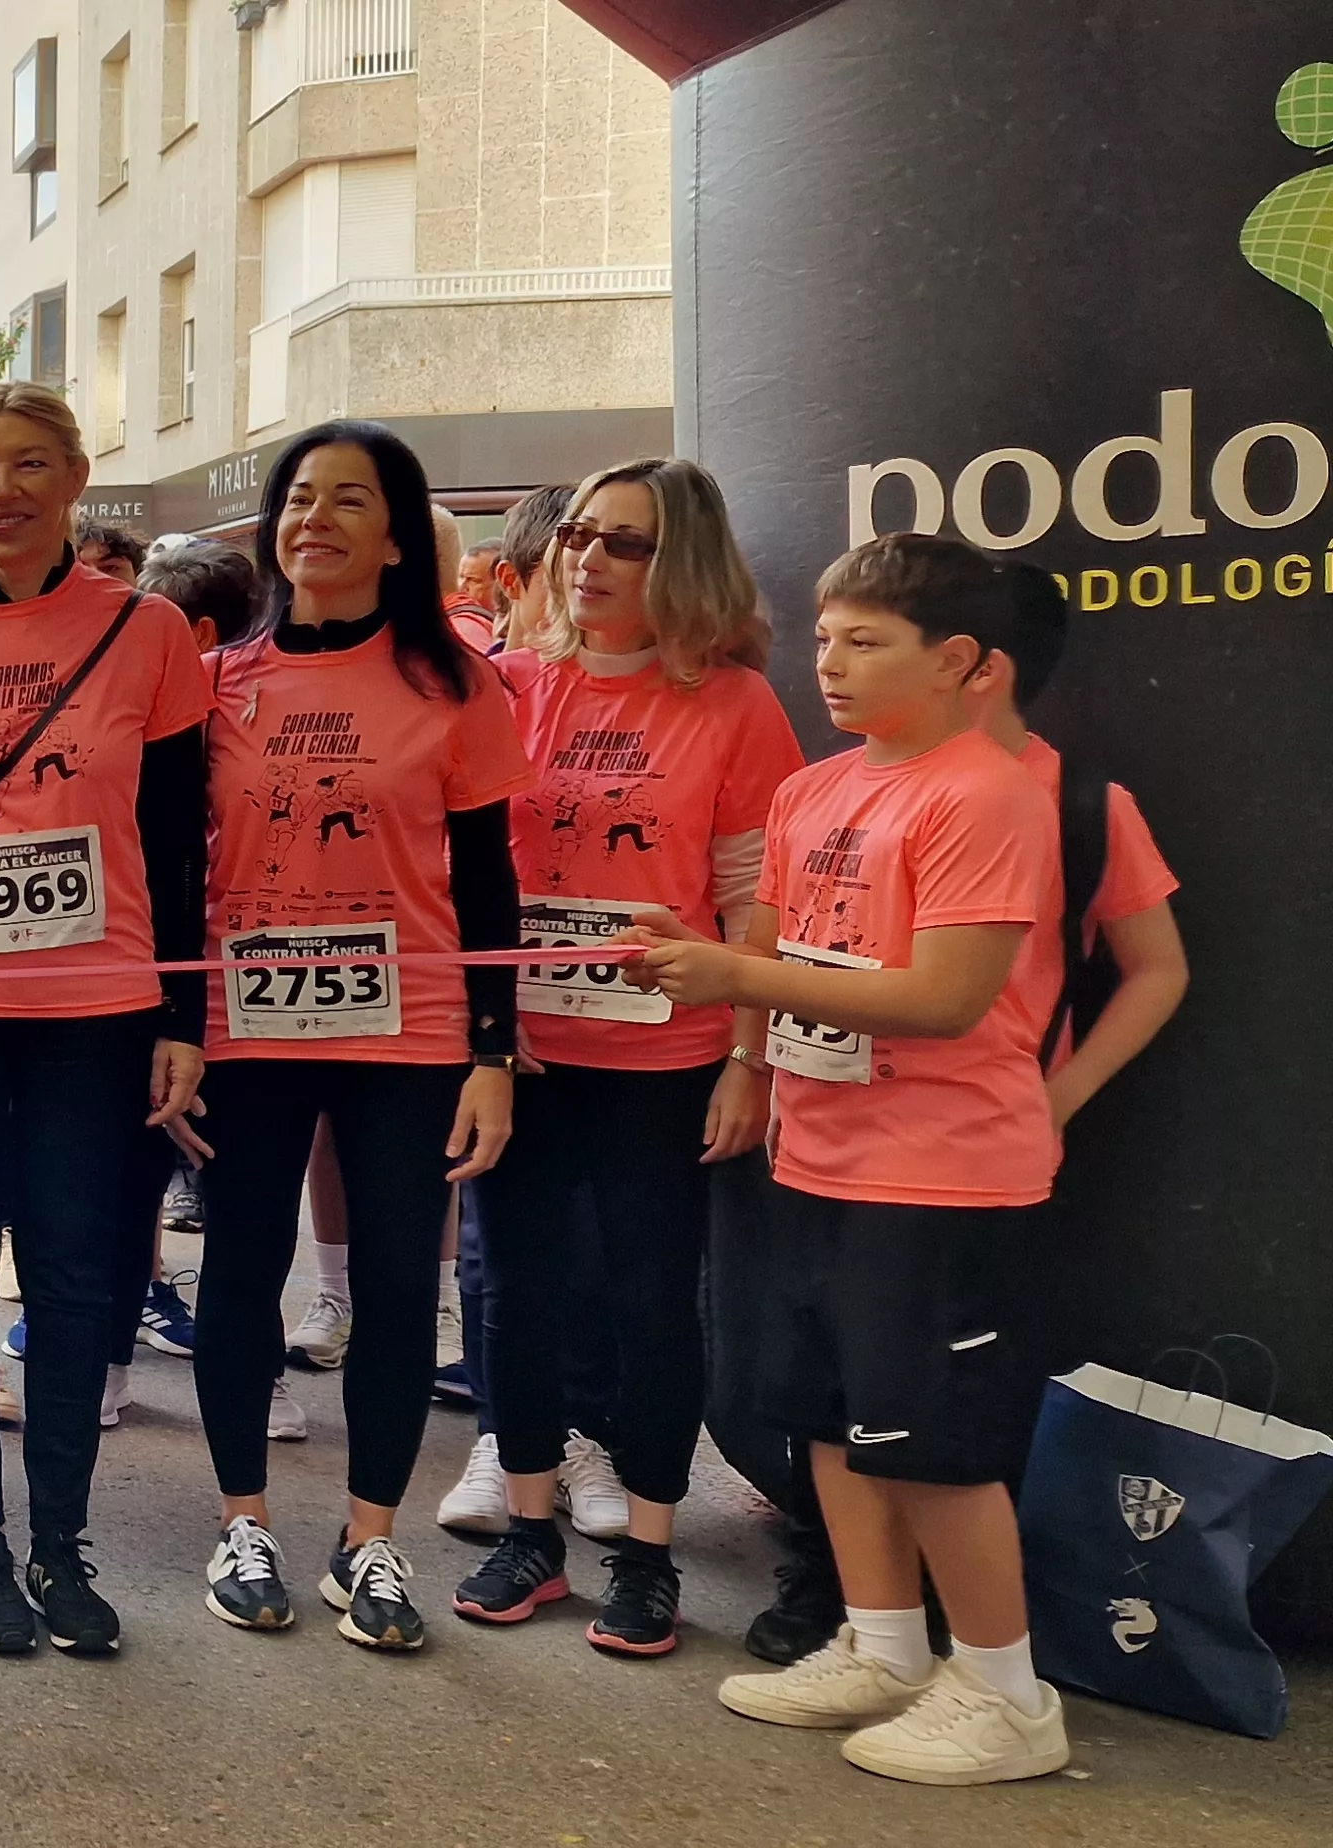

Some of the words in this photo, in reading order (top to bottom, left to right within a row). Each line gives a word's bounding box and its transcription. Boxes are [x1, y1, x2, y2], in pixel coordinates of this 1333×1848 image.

[208, 454, 258, 499] MIRATE
[849, 388, 1329, 550] podo
[76, 503, 143, 517] MIRATE
[1050, 538, 1333, 612] DOLOGÍ
[1, 688, 14, 709] LA
[280, 712, 354, 735] CORRAMOS
[262, 736, 290, 757] POR
[290, 735, 306, 755] LA
[307, 734, 361, 755] CIENCIA
[570, 730, 645, 751] CORRAMOS
[549, 750, 579, 769] POR
[578, 751, 595, 771] LA
[597, 751, 651, 771] CIENCIA
[11, 857, 28, 868] EL
[30, 850, 82, 866] CÁNCER
[520, 918, 576, 933] CONTRA
[578, 923, 596, 934] EL
[566, 911, 609, 923] HUESCA
[242, 948, 299, 960] CONTRA
[320, 945, 378, 957] CÁNCER
[288, 938, 329, 948] HUESCA
[520, 937, 619, 985] 196
[241, 963, 382, 1006] 2753
